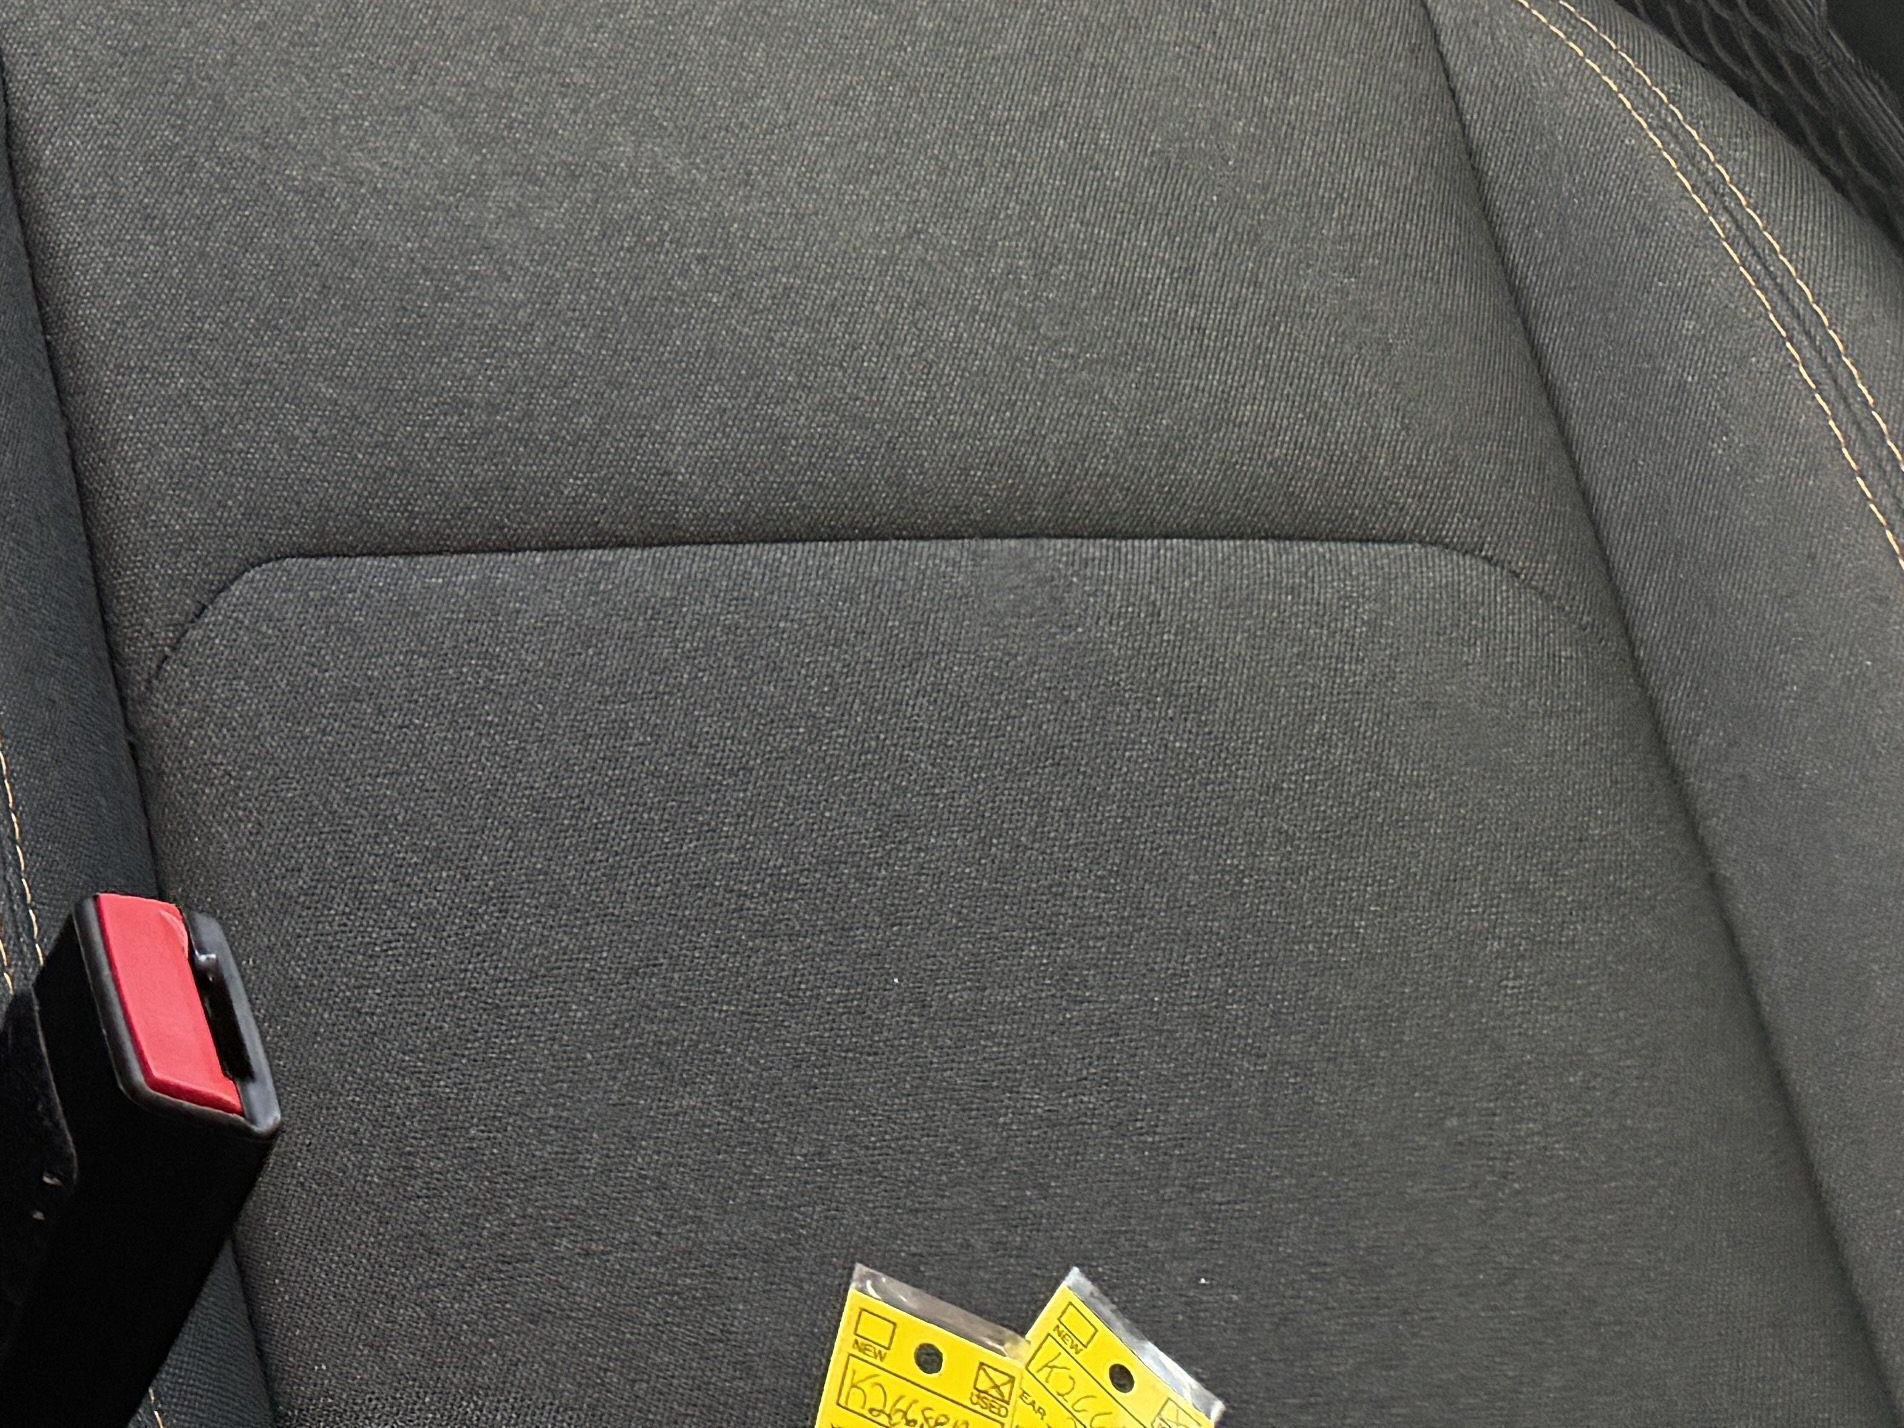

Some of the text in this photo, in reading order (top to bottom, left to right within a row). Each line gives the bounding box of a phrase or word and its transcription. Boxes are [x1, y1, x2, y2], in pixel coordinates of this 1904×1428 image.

[852, 1338, 888, 1363] NEW
[1053, 1324, 1084, 1356] NEW
[969, 1391, 1009, 1419] USED
[1019, 1387, 1047, 1417] EAR
